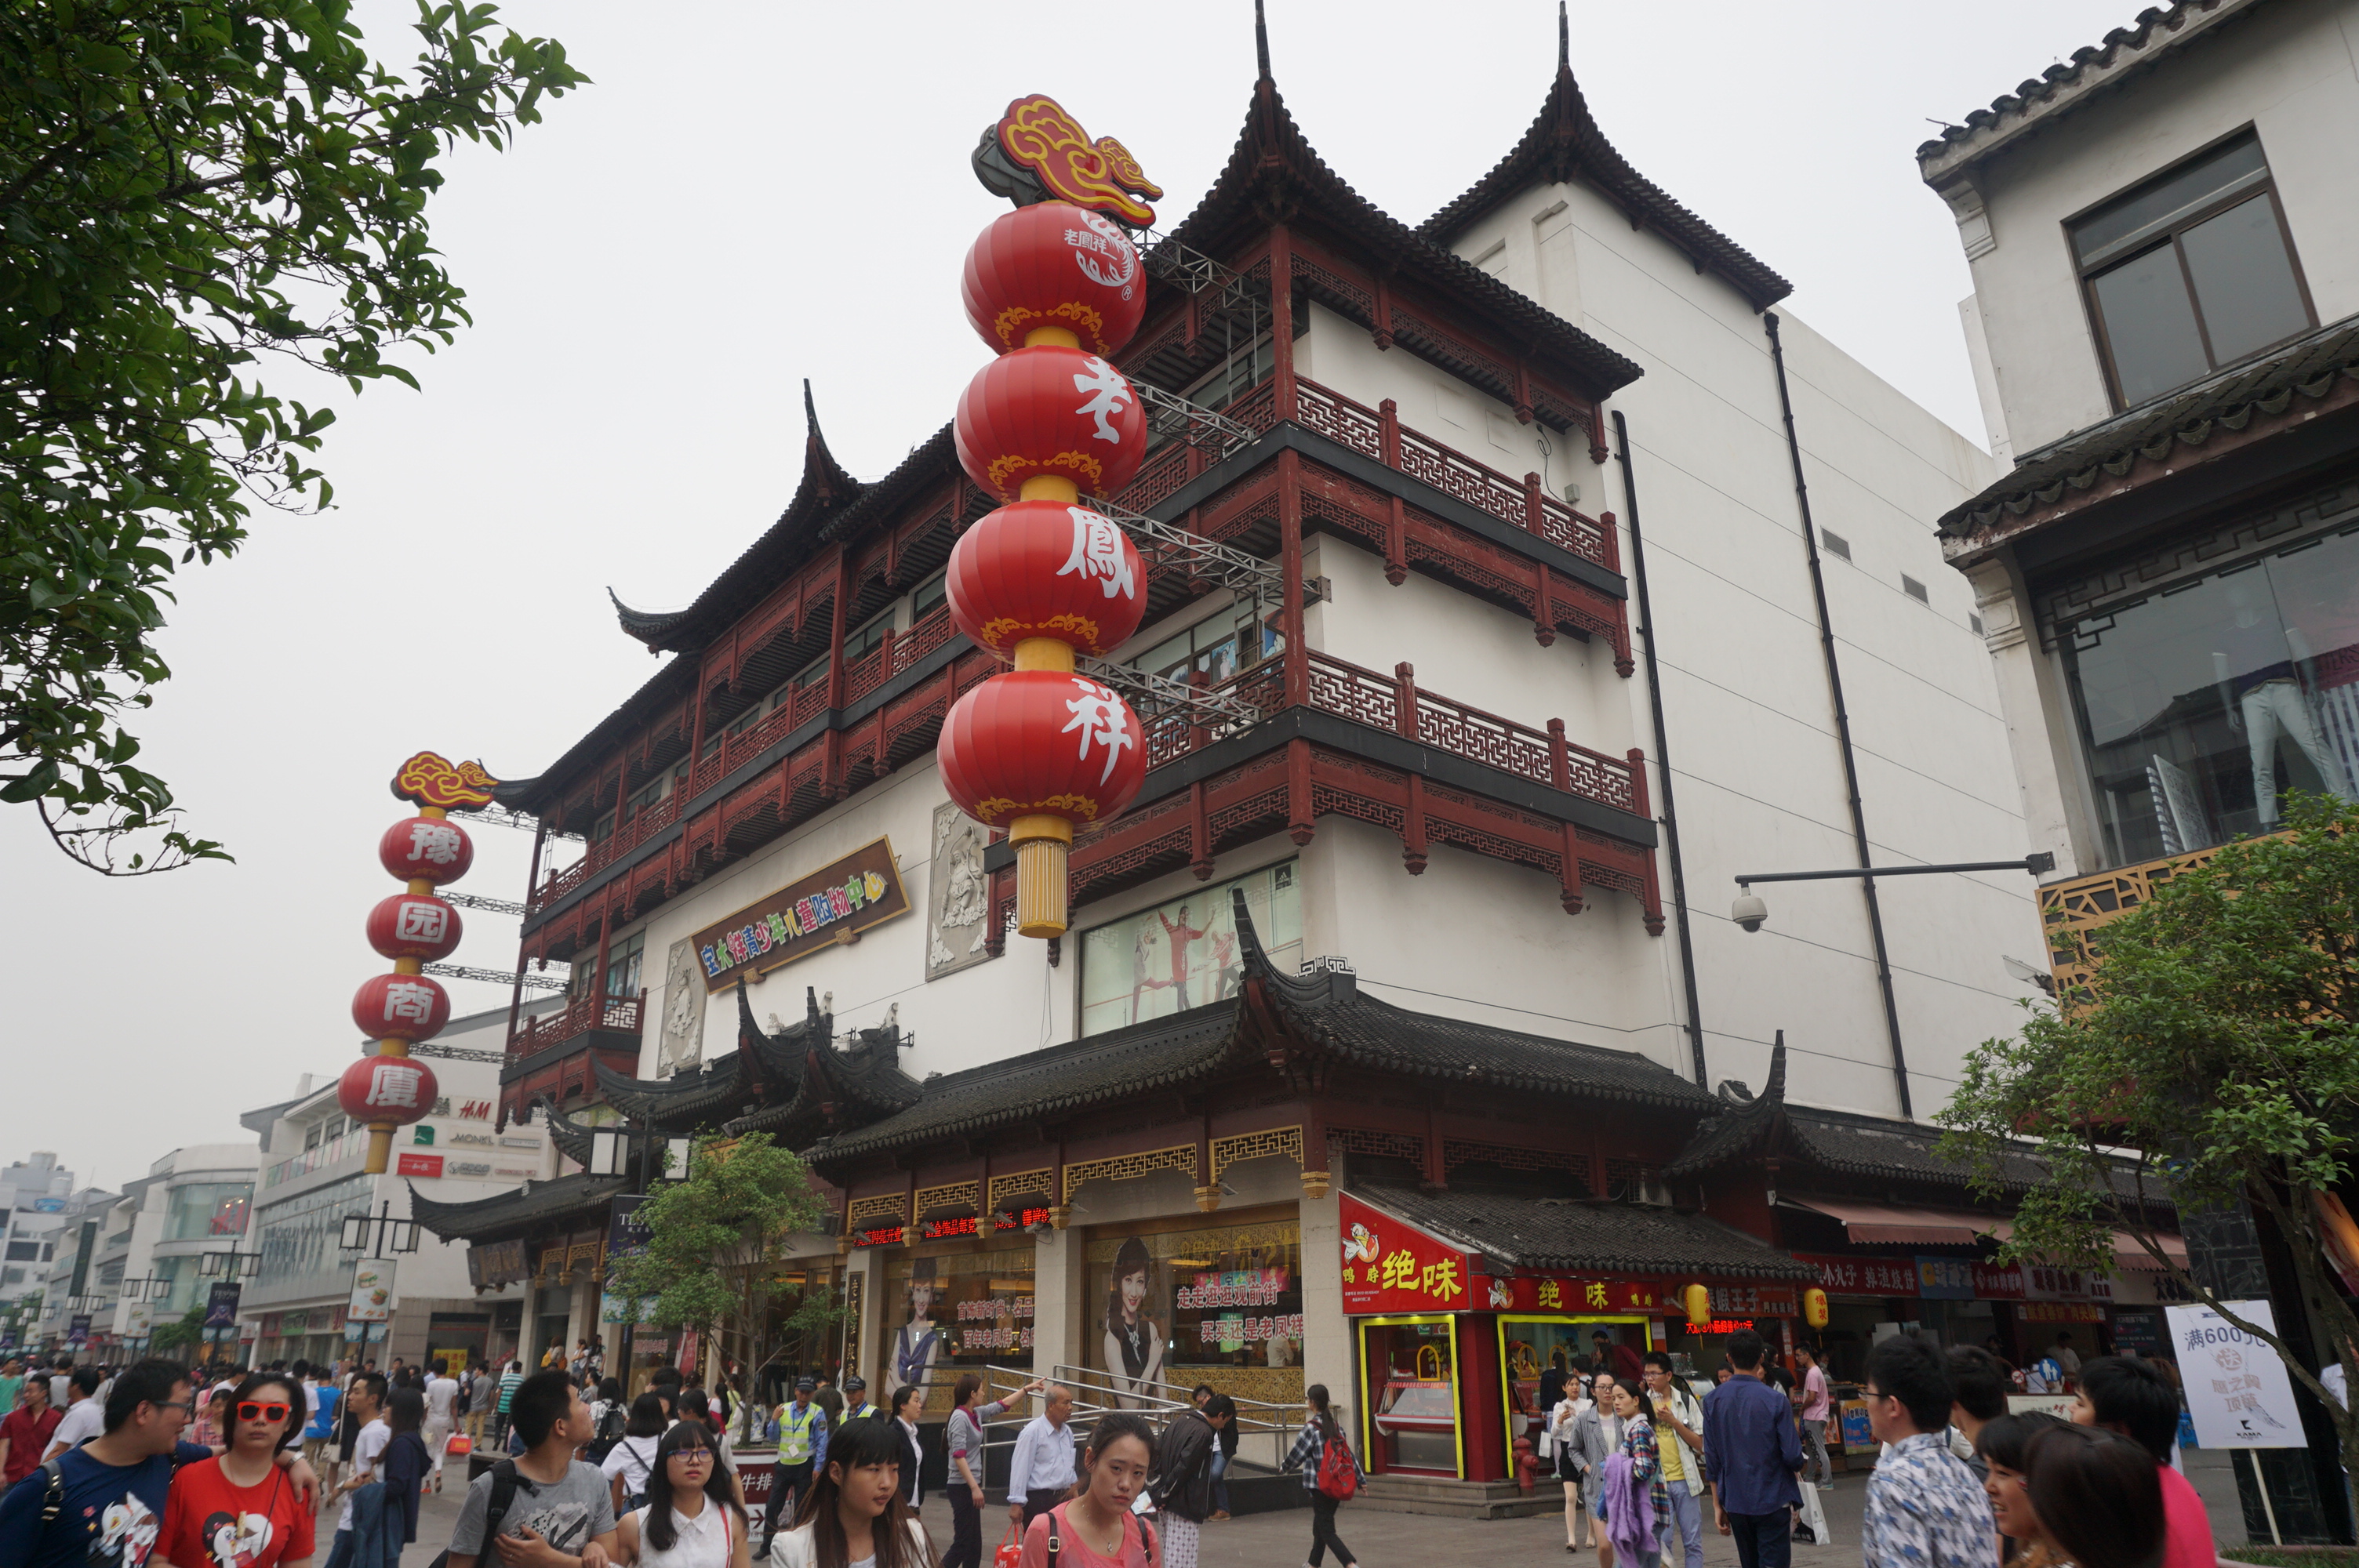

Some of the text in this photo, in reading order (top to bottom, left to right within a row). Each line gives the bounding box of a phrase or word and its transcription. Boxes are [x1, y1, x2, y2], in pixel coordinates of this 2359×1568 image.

[700, 870, 888, 978] 宝大祥青少年儿童购物中心
[459, 1099, 491, 1120] H&M
[1382, 1249, 1463, 1302] 绝味
[1177, 1282, 1278, 1309] 走走逛逛观前街
[1539, 1281, 1608, 1310] 绝味
[1201, 1313, 1303, 1343] 买买还是老凤祥
[741, 1472, 772, 1491] 牛排
